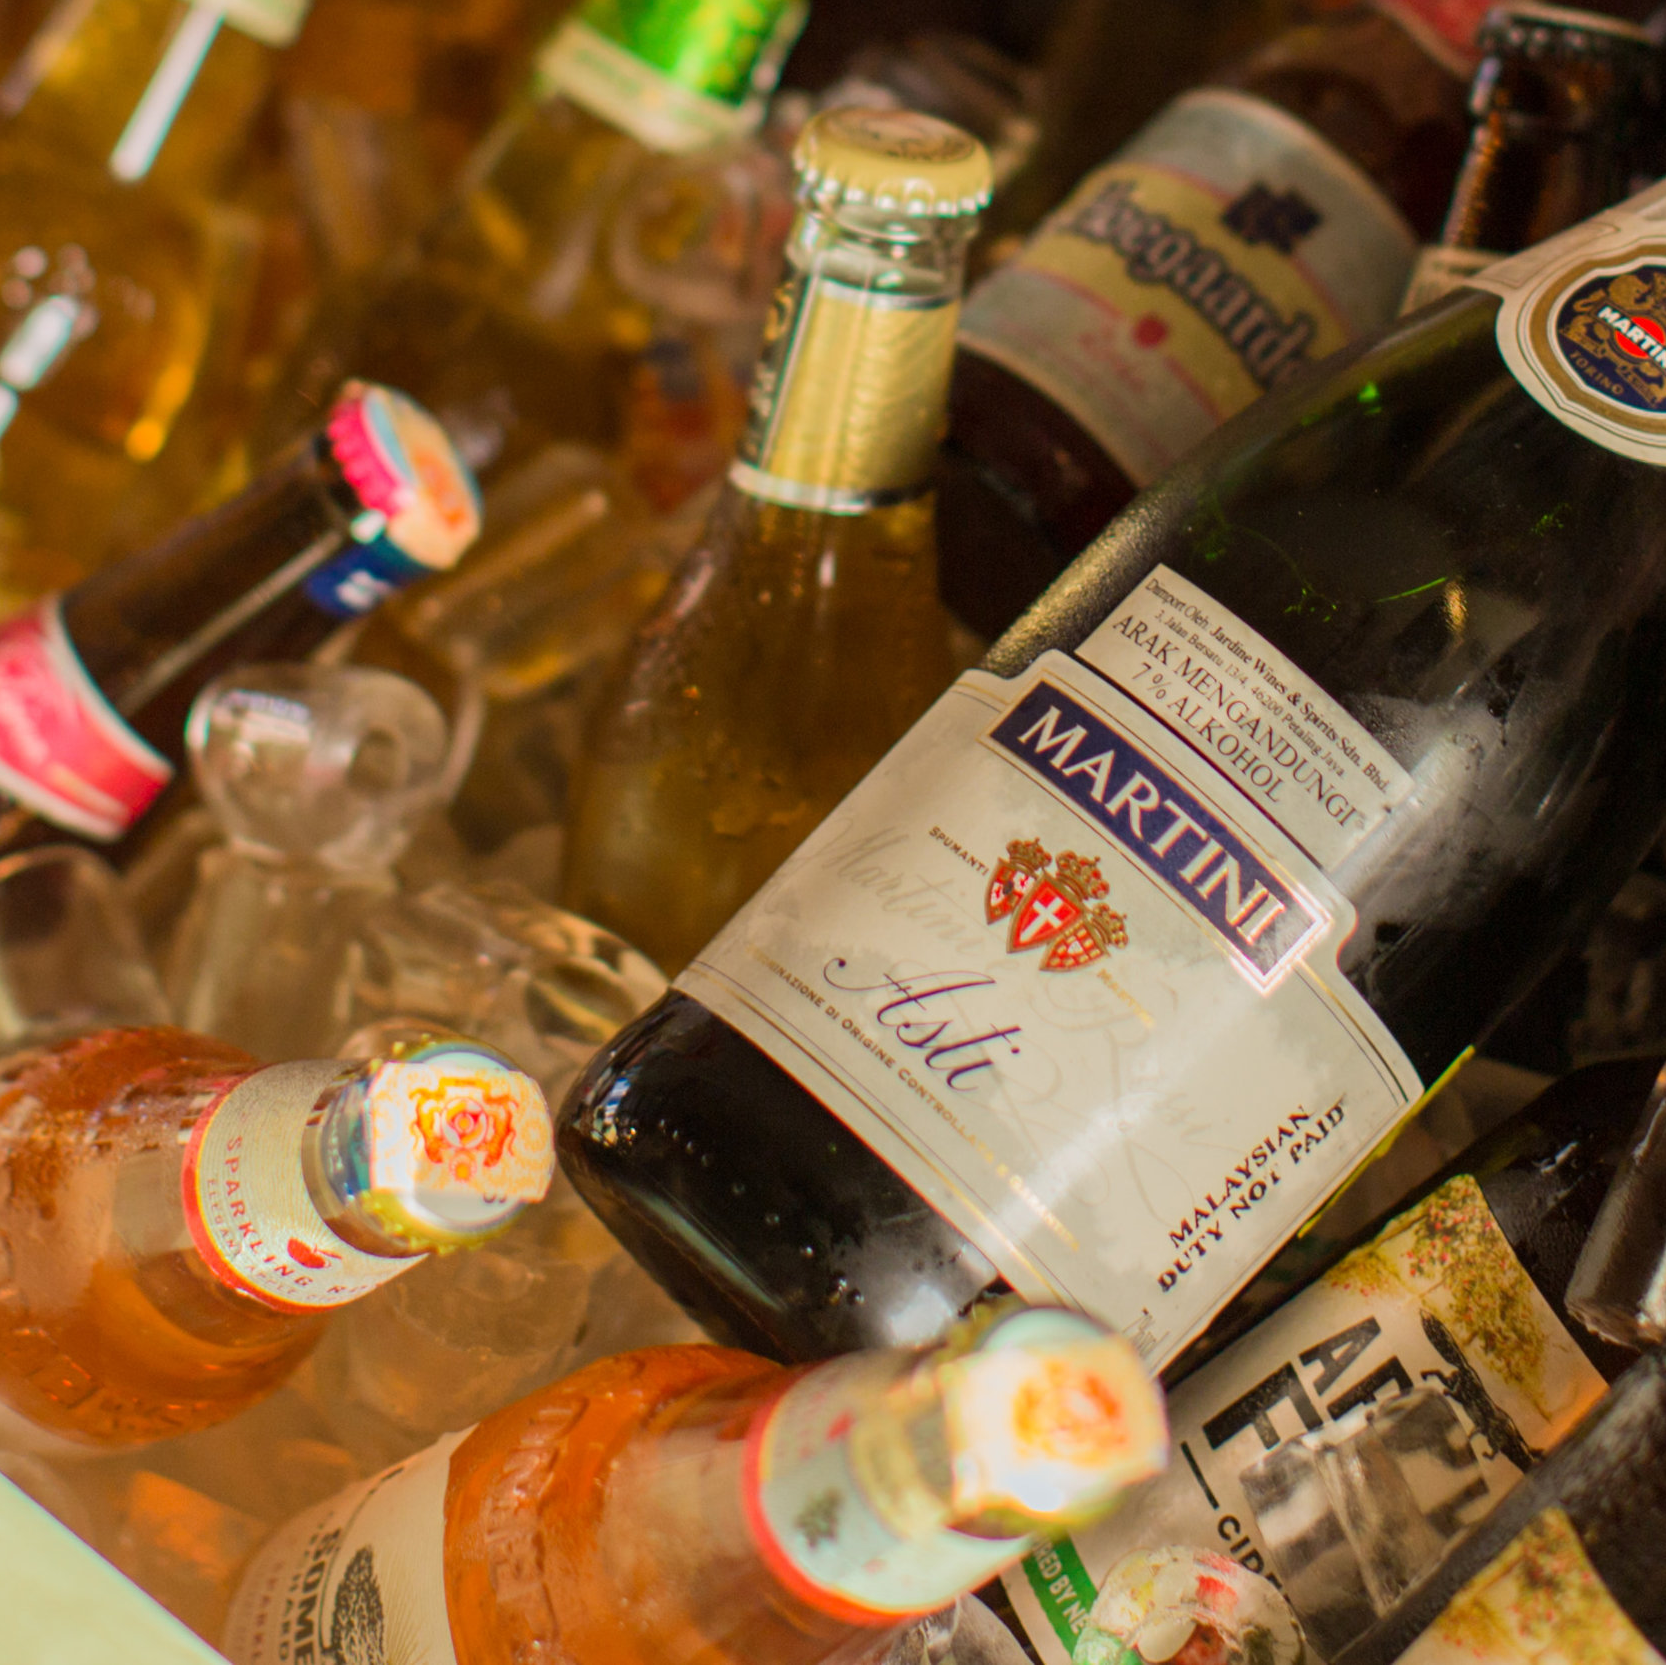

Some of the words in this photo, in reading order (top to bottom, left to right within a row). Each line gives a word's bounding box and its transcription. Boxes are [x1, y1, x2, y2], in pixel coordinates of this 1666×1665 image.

[1112, 613, 1180, 668] ARAK
[1173, 654, 1359, 828] MENGANDUNGI
[1166, 695, 1286, 804] ALKOHOL
[1208, 624, 1255, 664] Jardine
[1253, 657, 1290, 697] Wines
[1286, 691, 1303, 709] &
[1335, 735, 1363, 768] Sdn.
[927, 825, 991, 879] SPUMANTI
[1016, 702, 1290, 949] MARTINI
[821, 955, 1025, 1094] Asti
[840, 1017, 897, 1071] ORIGINE
[223, 1133, 316, 1290] SPARKLING
[1155, 1220, 1226, 1294] DUTY
[1229, 1164, 1283, 1220] NOT
[1288, 1101, 1347, 1165] PAID
[1168, 1103, 1316, 1250] MALAYSIAN
[1048, 1575, 1076, 1608] BY
